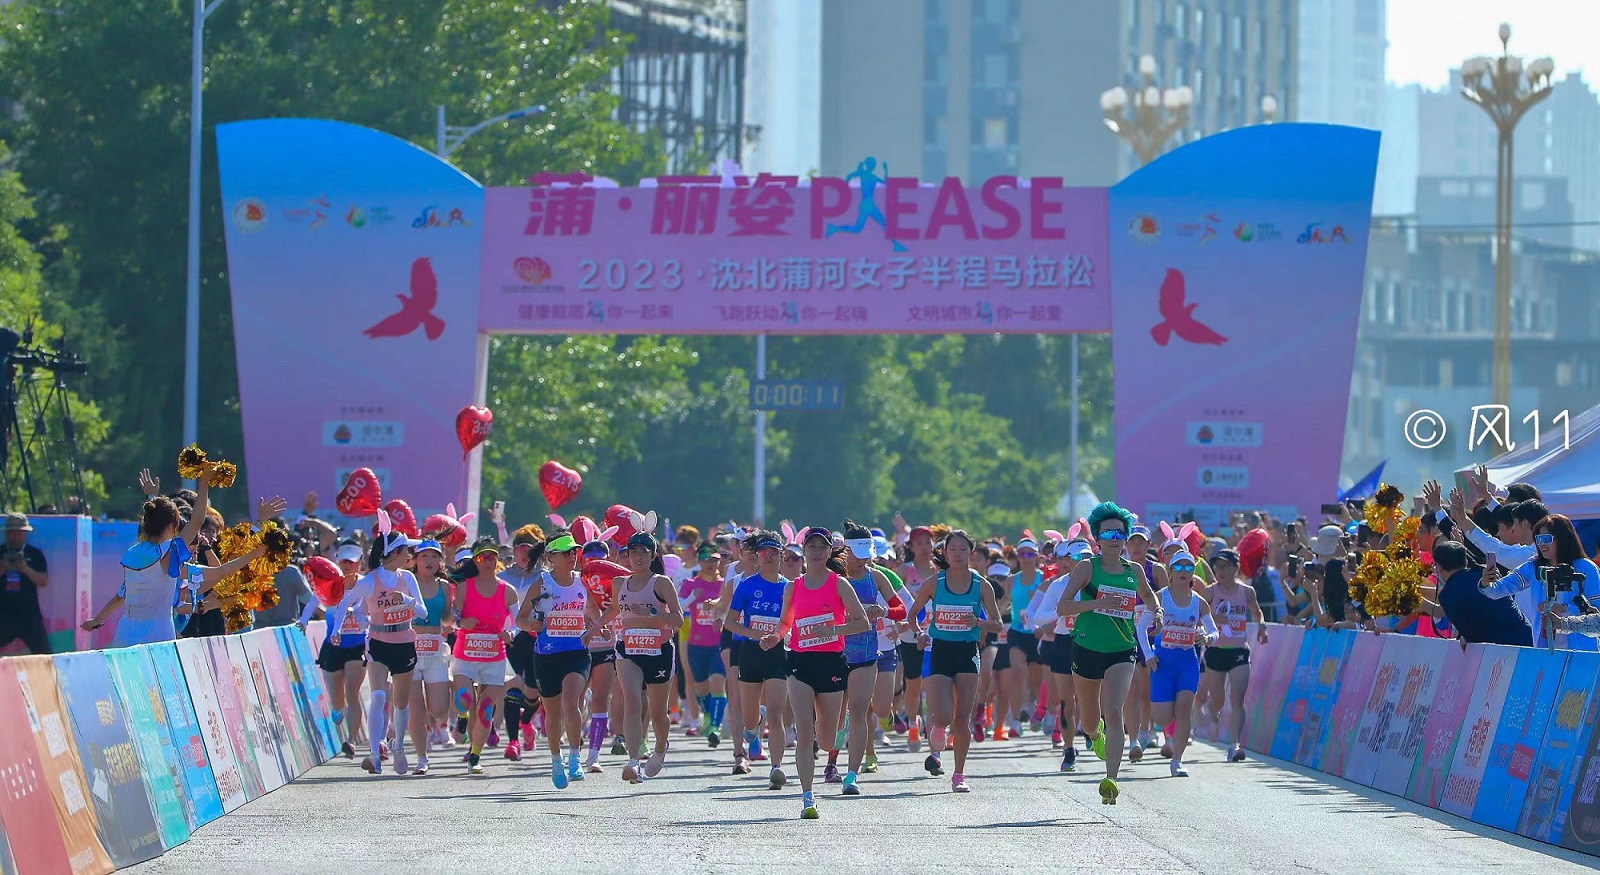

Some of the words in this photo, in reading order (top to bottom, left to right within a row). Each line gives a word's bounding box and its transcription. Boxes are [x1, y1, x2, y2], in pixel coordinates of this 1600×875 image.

[809, 176, 1066, 241] PEASE
[551, 469, 579, 492] 2:15
[340, 476, 367, 512] 2:00
[550, 618, 578, 626] A0620
[752, 622, 776, 632] A063
[627, 636, 655, 645] A1275
[1165, 631, 1190, 641] A0633
[466, 640, 493, 649] A0096
